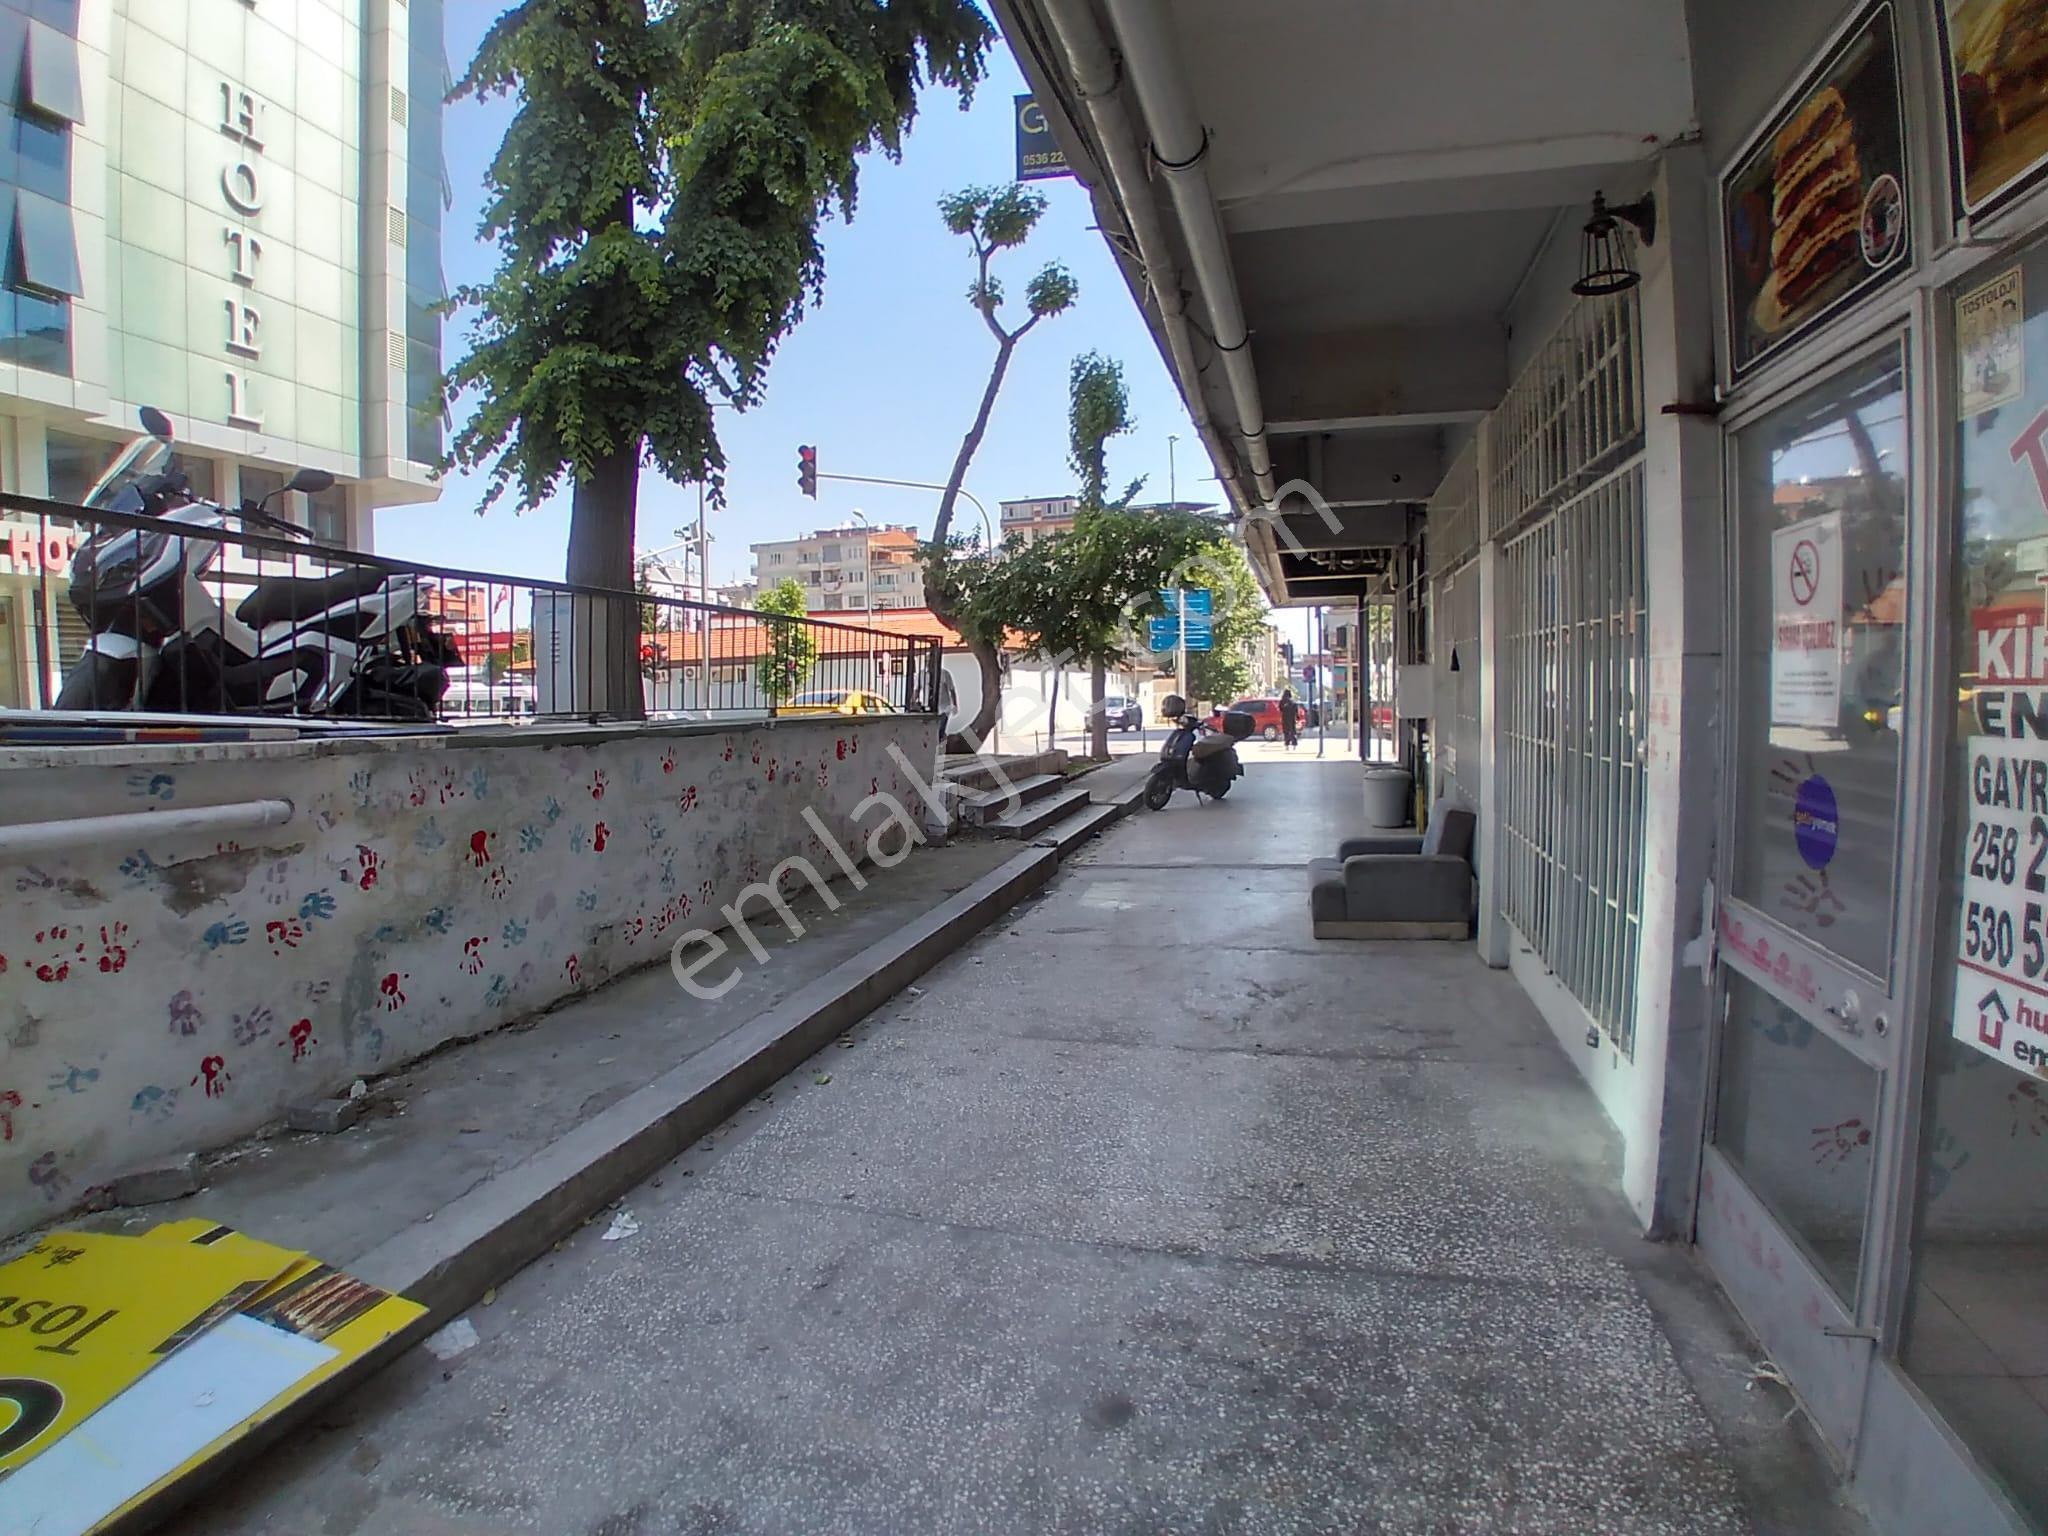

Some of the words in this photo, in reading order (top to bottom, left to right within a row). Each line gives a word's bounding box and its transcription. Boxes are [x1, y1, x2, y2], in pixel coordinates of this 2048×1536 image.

[1050, 151, 1067, 163] 22
[219, 82, 266, 433] HOTEL
[1970, 822, 2018, 885] 258
[1966, 901, 2014, 968] 530
[2023, 902, 2048, 982] 5
